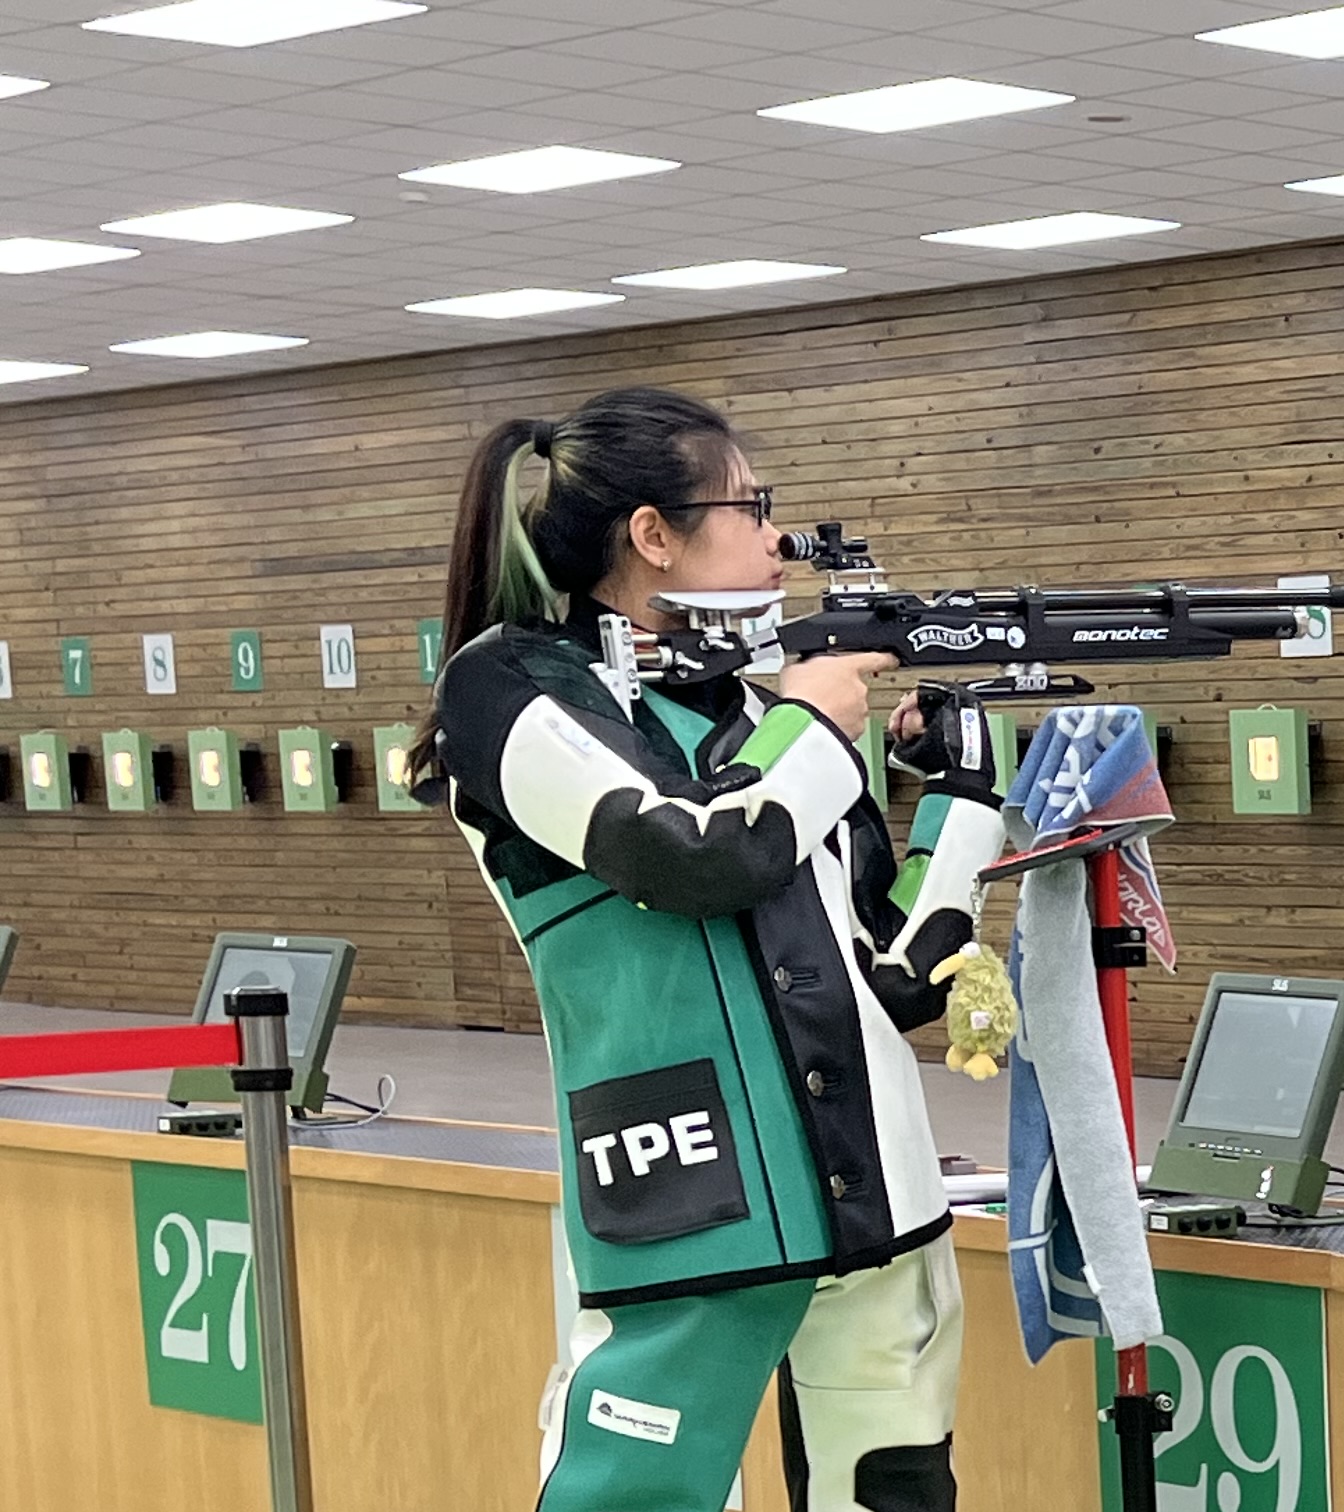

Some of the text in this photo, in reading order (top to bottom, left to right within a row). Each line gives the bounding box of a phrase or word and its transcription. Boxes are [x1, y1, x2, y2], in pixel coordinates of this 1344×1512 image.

[917, 630, 973, 645] WALTHER
[1073, 626, 1169, 642] monotec
[68, 650, 84, 685] 7
[151, 646, 168, 682] 8
[237, 641, 256, 680] 9
[325, 637, 352, 675] 10
[581, 1111, 719, 1188] TPE
[153, 1212, 253, 1372] 27
